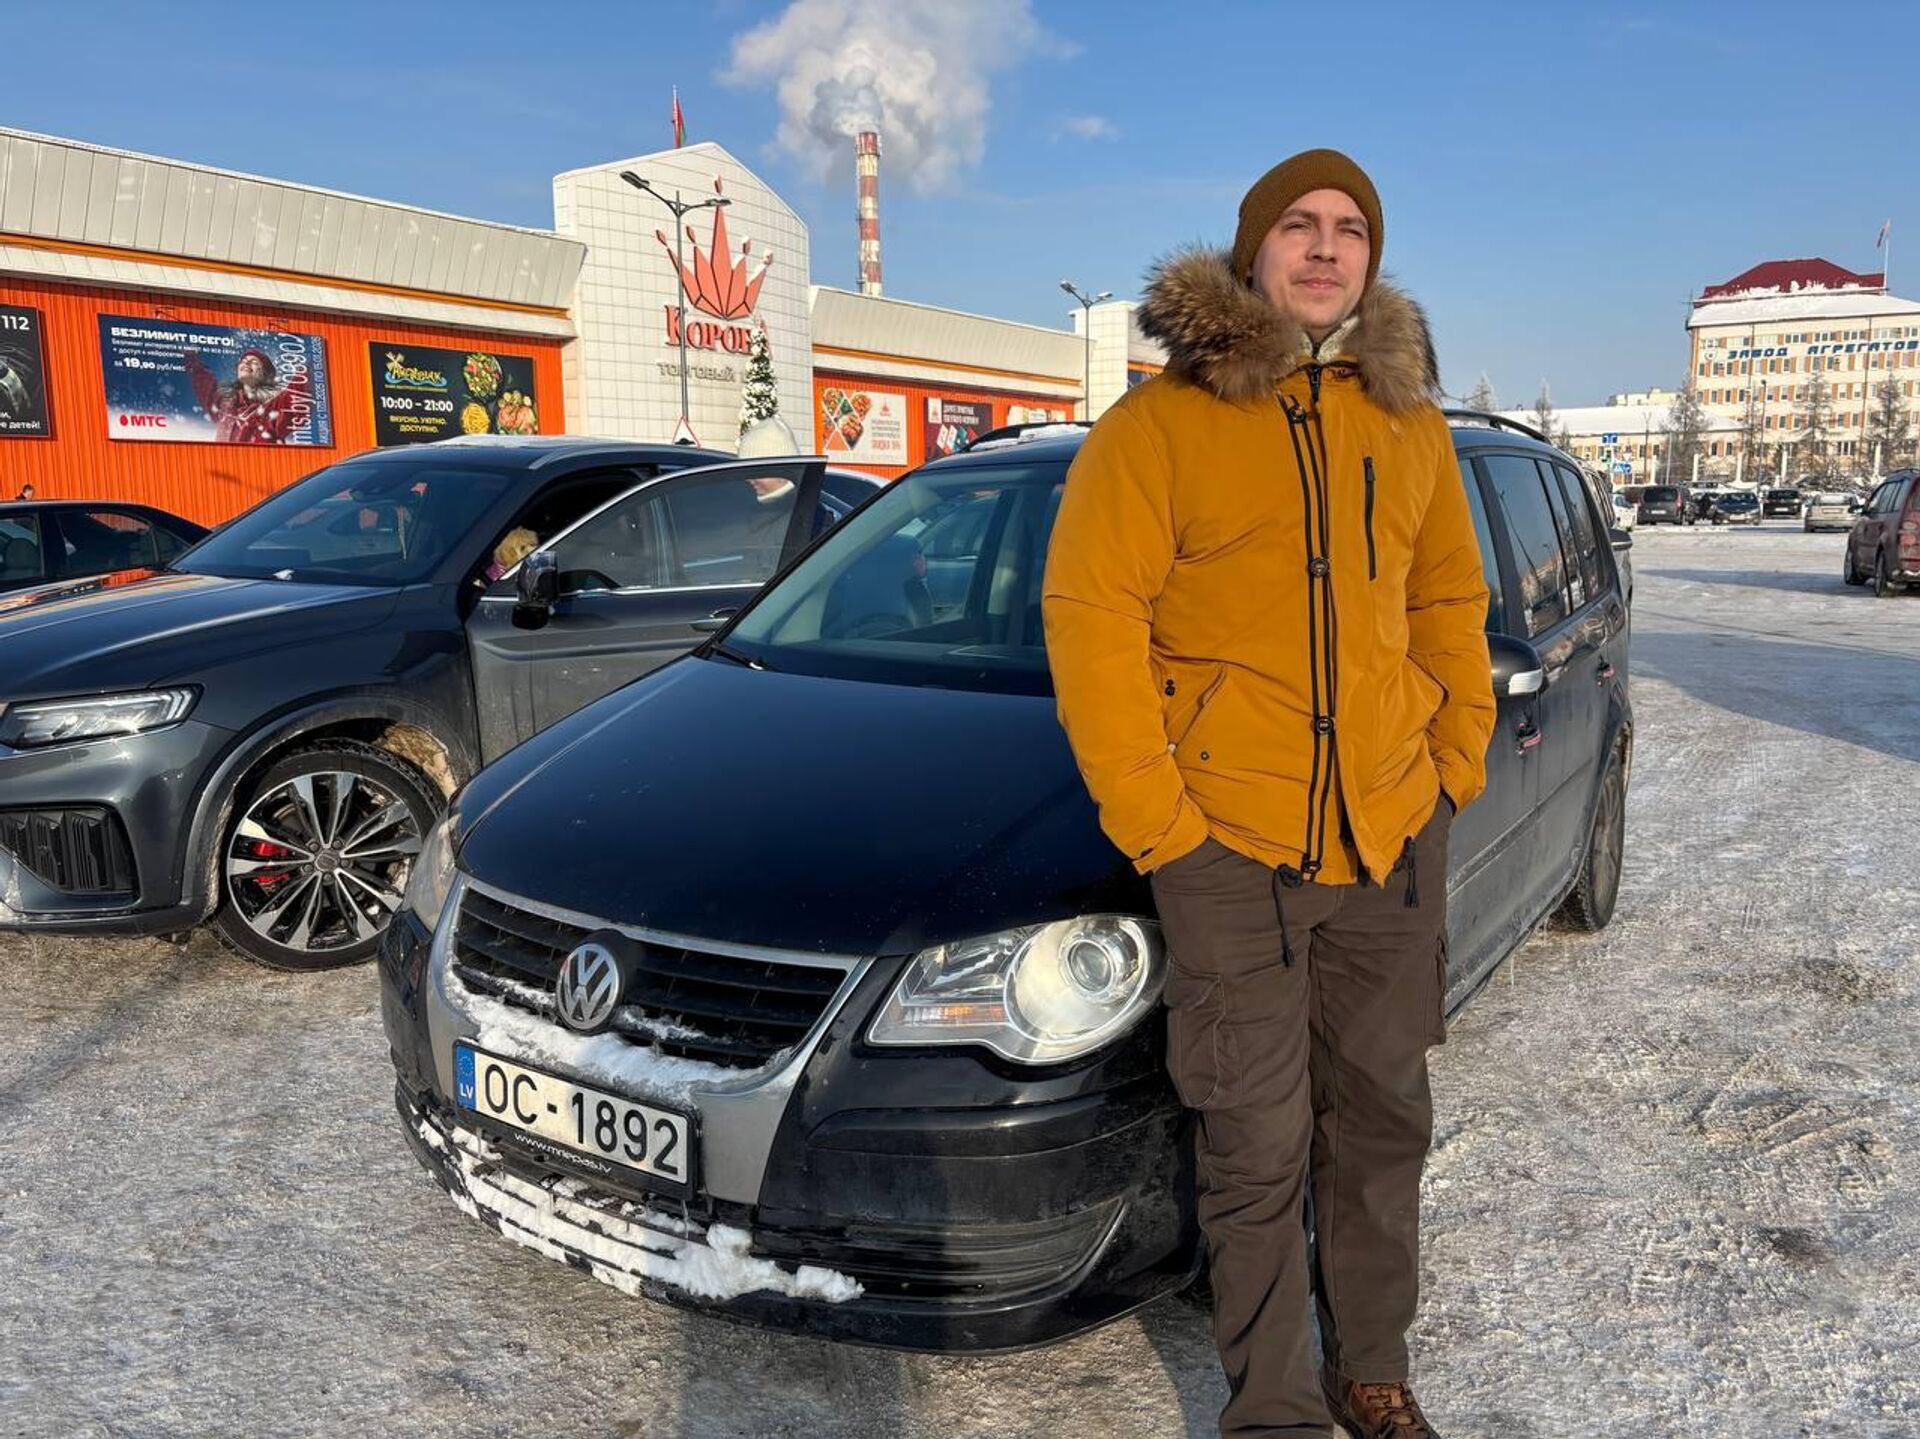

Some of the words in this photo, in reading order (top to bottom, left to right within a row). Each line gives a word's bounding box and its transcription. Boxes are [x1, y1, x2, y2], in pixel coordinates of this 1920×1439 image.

[1, 315, 30, 330] 112
[111, 327, 187, 342] БЕЗЛИМИТ
[189, 334, 234, 347] ВСЕГО!
[1727, 347, 1788, 360] ЗАВОД
[1807, 340, 1919, 355] АГРЕГАТОВ
[657, 363, 735, 383] ТОГОВЫЙ
[381, 396, 413, 410] 10:00
[424, 399, 454, 413] 21:00
[130, 415, 167, 427] МТС
[459, 1082, 474, 1099] LV
[484, 1063, 679, 1175] OC-1892
